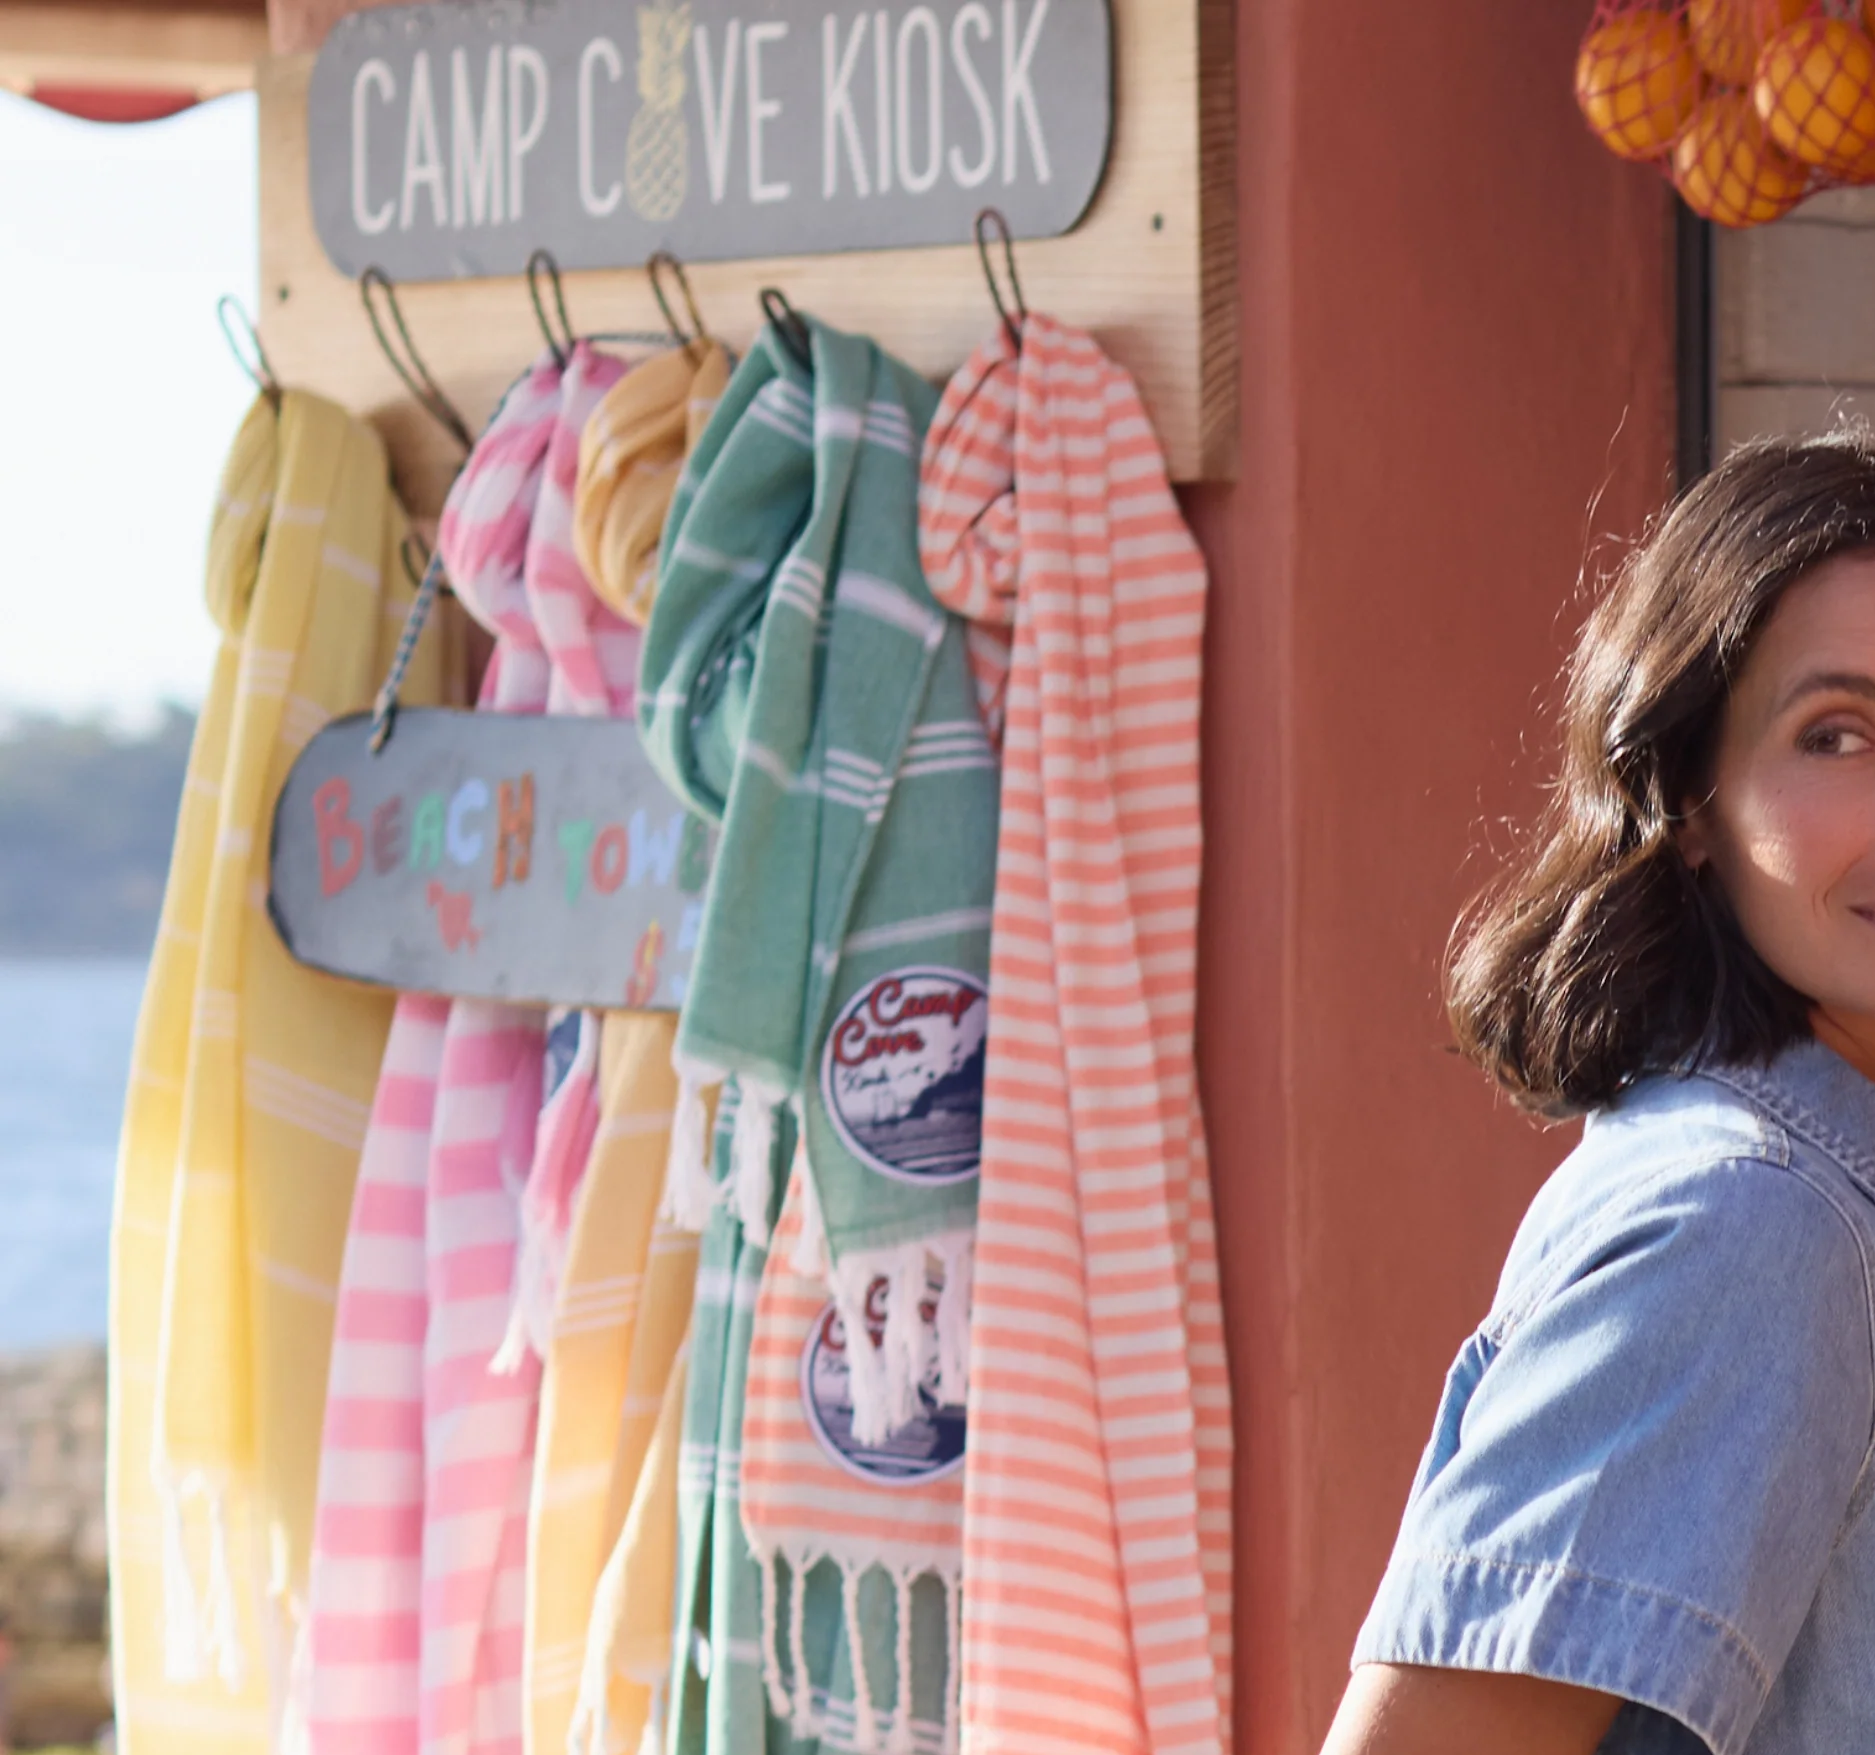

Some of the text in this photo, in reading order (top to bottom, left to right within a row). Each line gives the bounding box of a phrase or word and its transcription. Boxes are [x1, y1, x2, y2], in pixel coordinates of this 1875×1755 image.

[352, 45, 548, 233] CAMP
[822, 0, 1052, 198] KIOSK
[312, 770, 712, 906] BEACH TOWE
